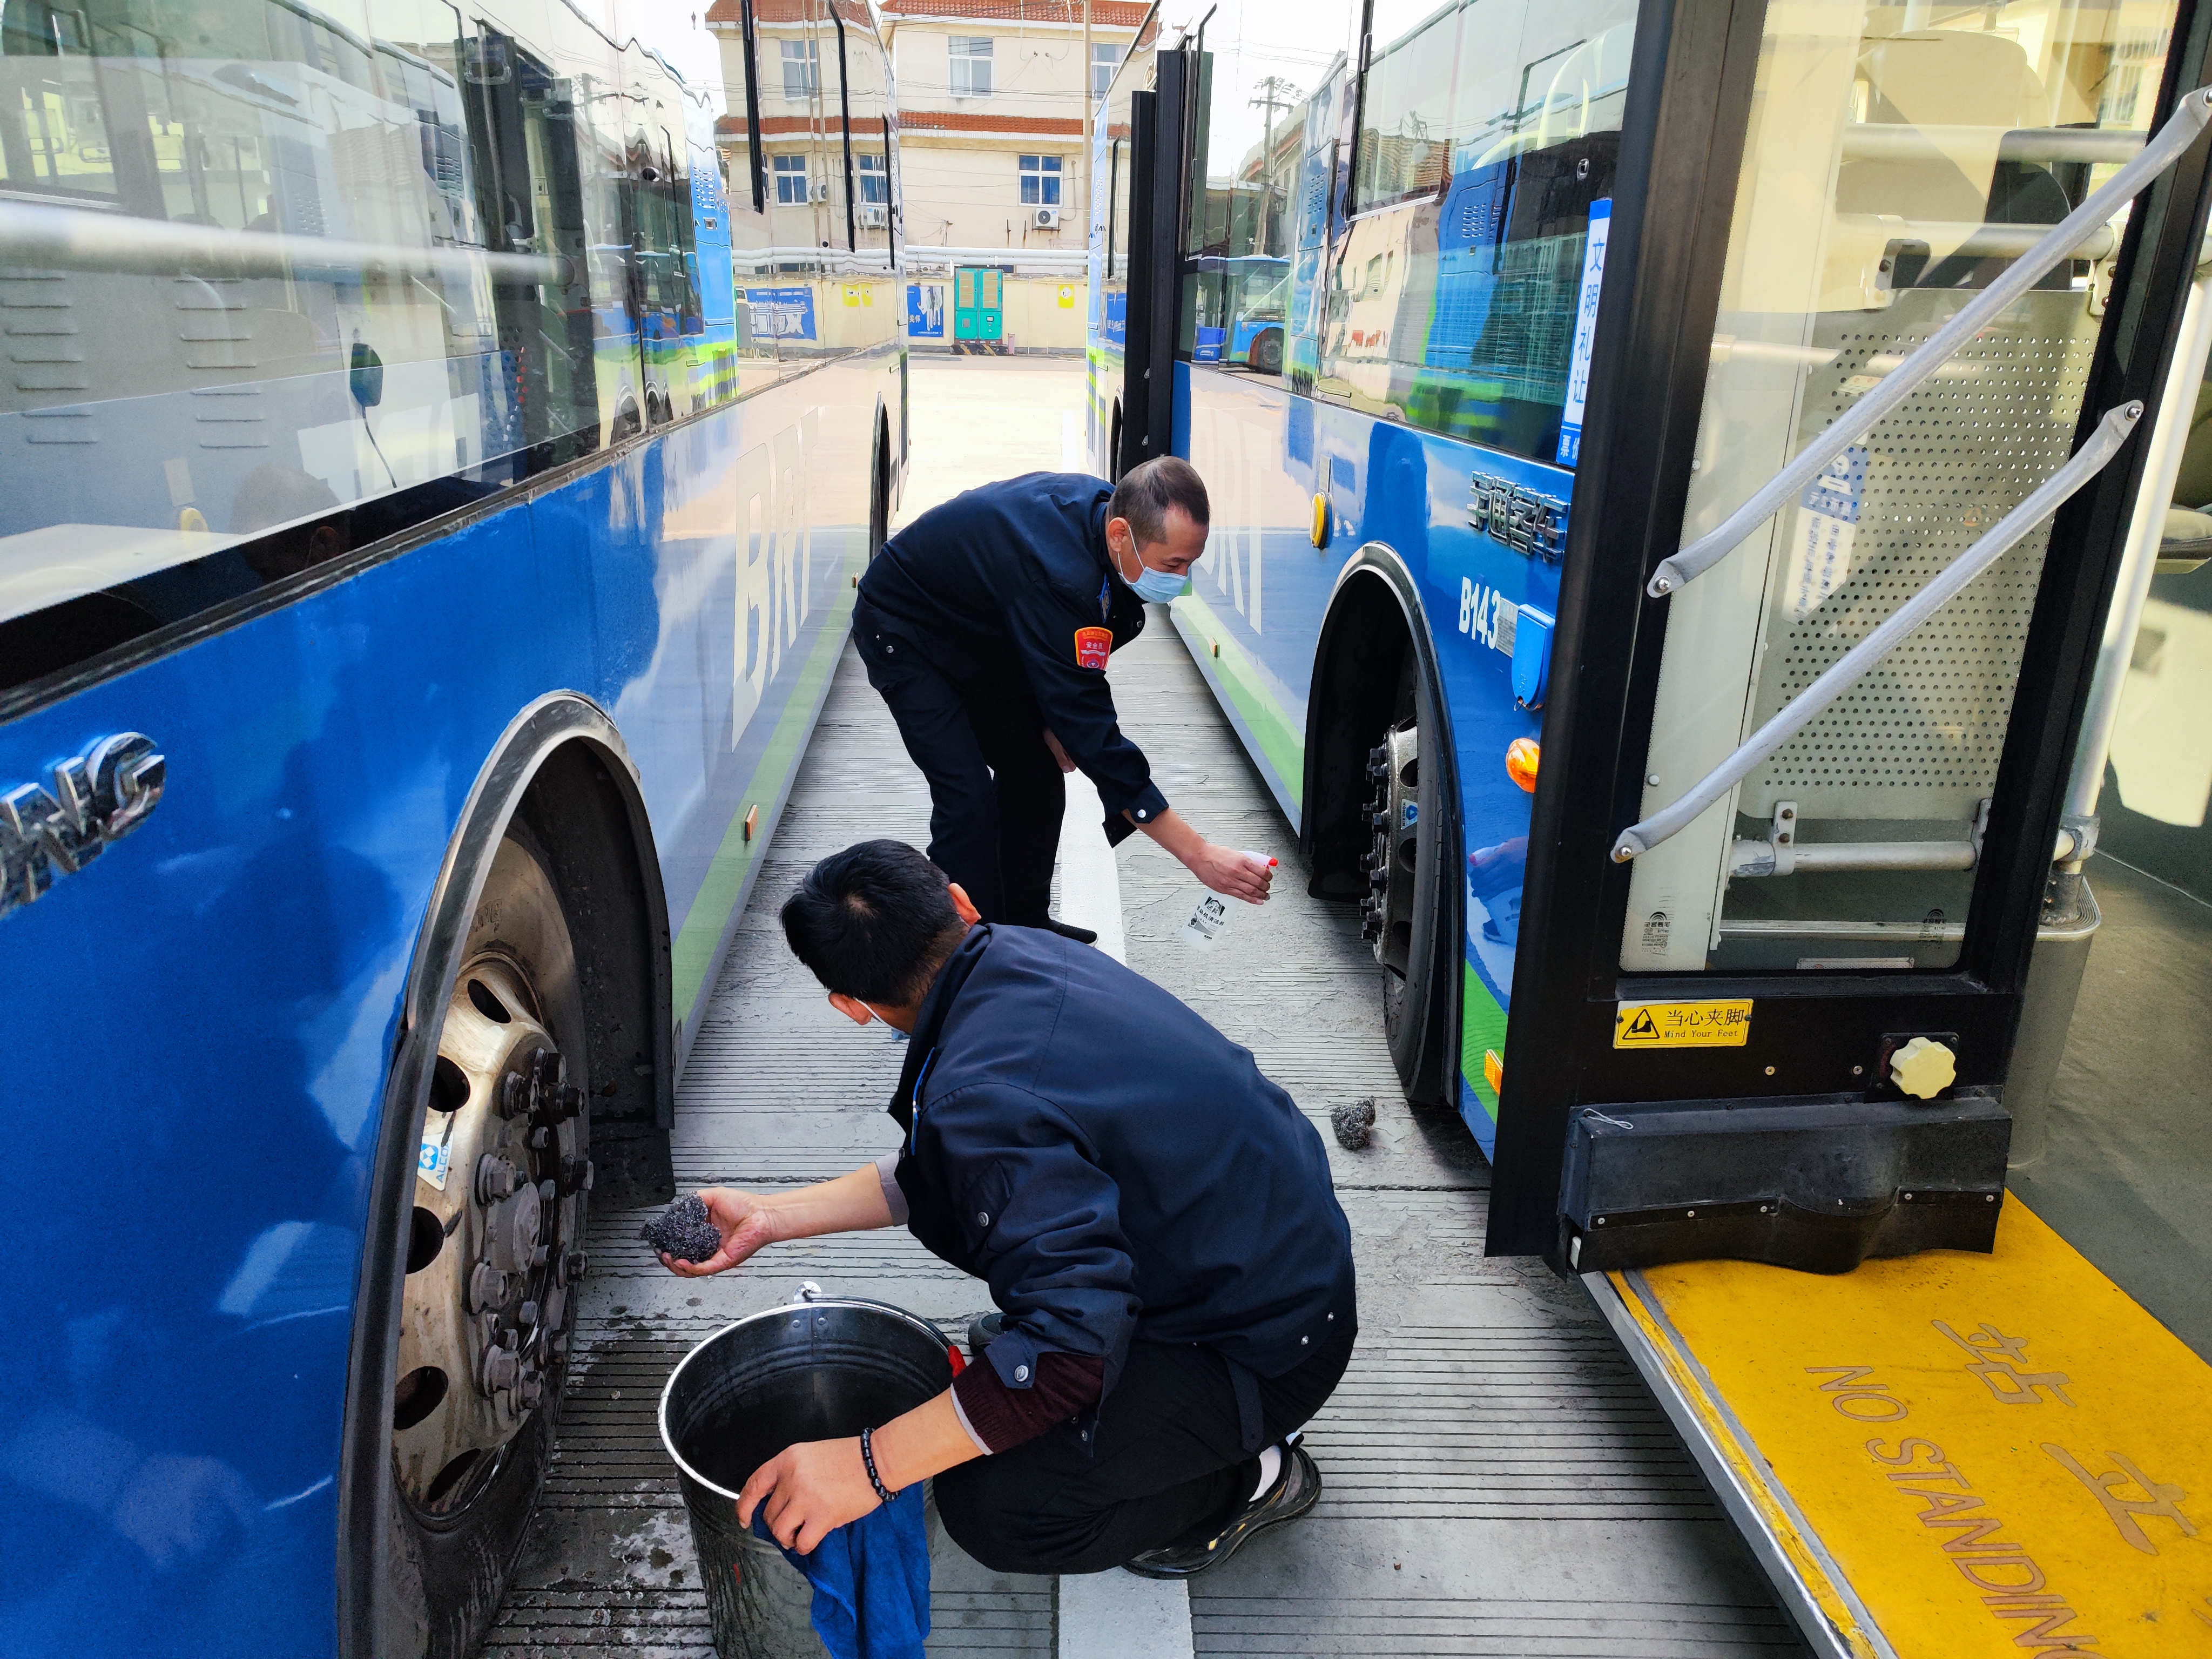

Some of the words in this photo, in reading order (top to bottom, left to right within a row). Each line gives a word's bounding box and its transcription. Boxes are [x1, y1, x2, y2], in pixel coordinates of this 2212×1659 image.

[1573, 237, 1605, 404] 文明礼让
[732, 406, 819, 753] BRT
[1467, 470, 1571, 563] 宇通客车
[1459, 576, 1501, 650] B143
[0, 732, 166, 921] NG
[1663, 1030, 1686, 1038] Mind
[1717, 1029, 1738, 1037] Feet
[1664, 1008, 1745, 1027] 当心夹脚
[1804, 1365, 1909, 1422] NO
[1865, 1437, 2109, 1659] STANDIN
